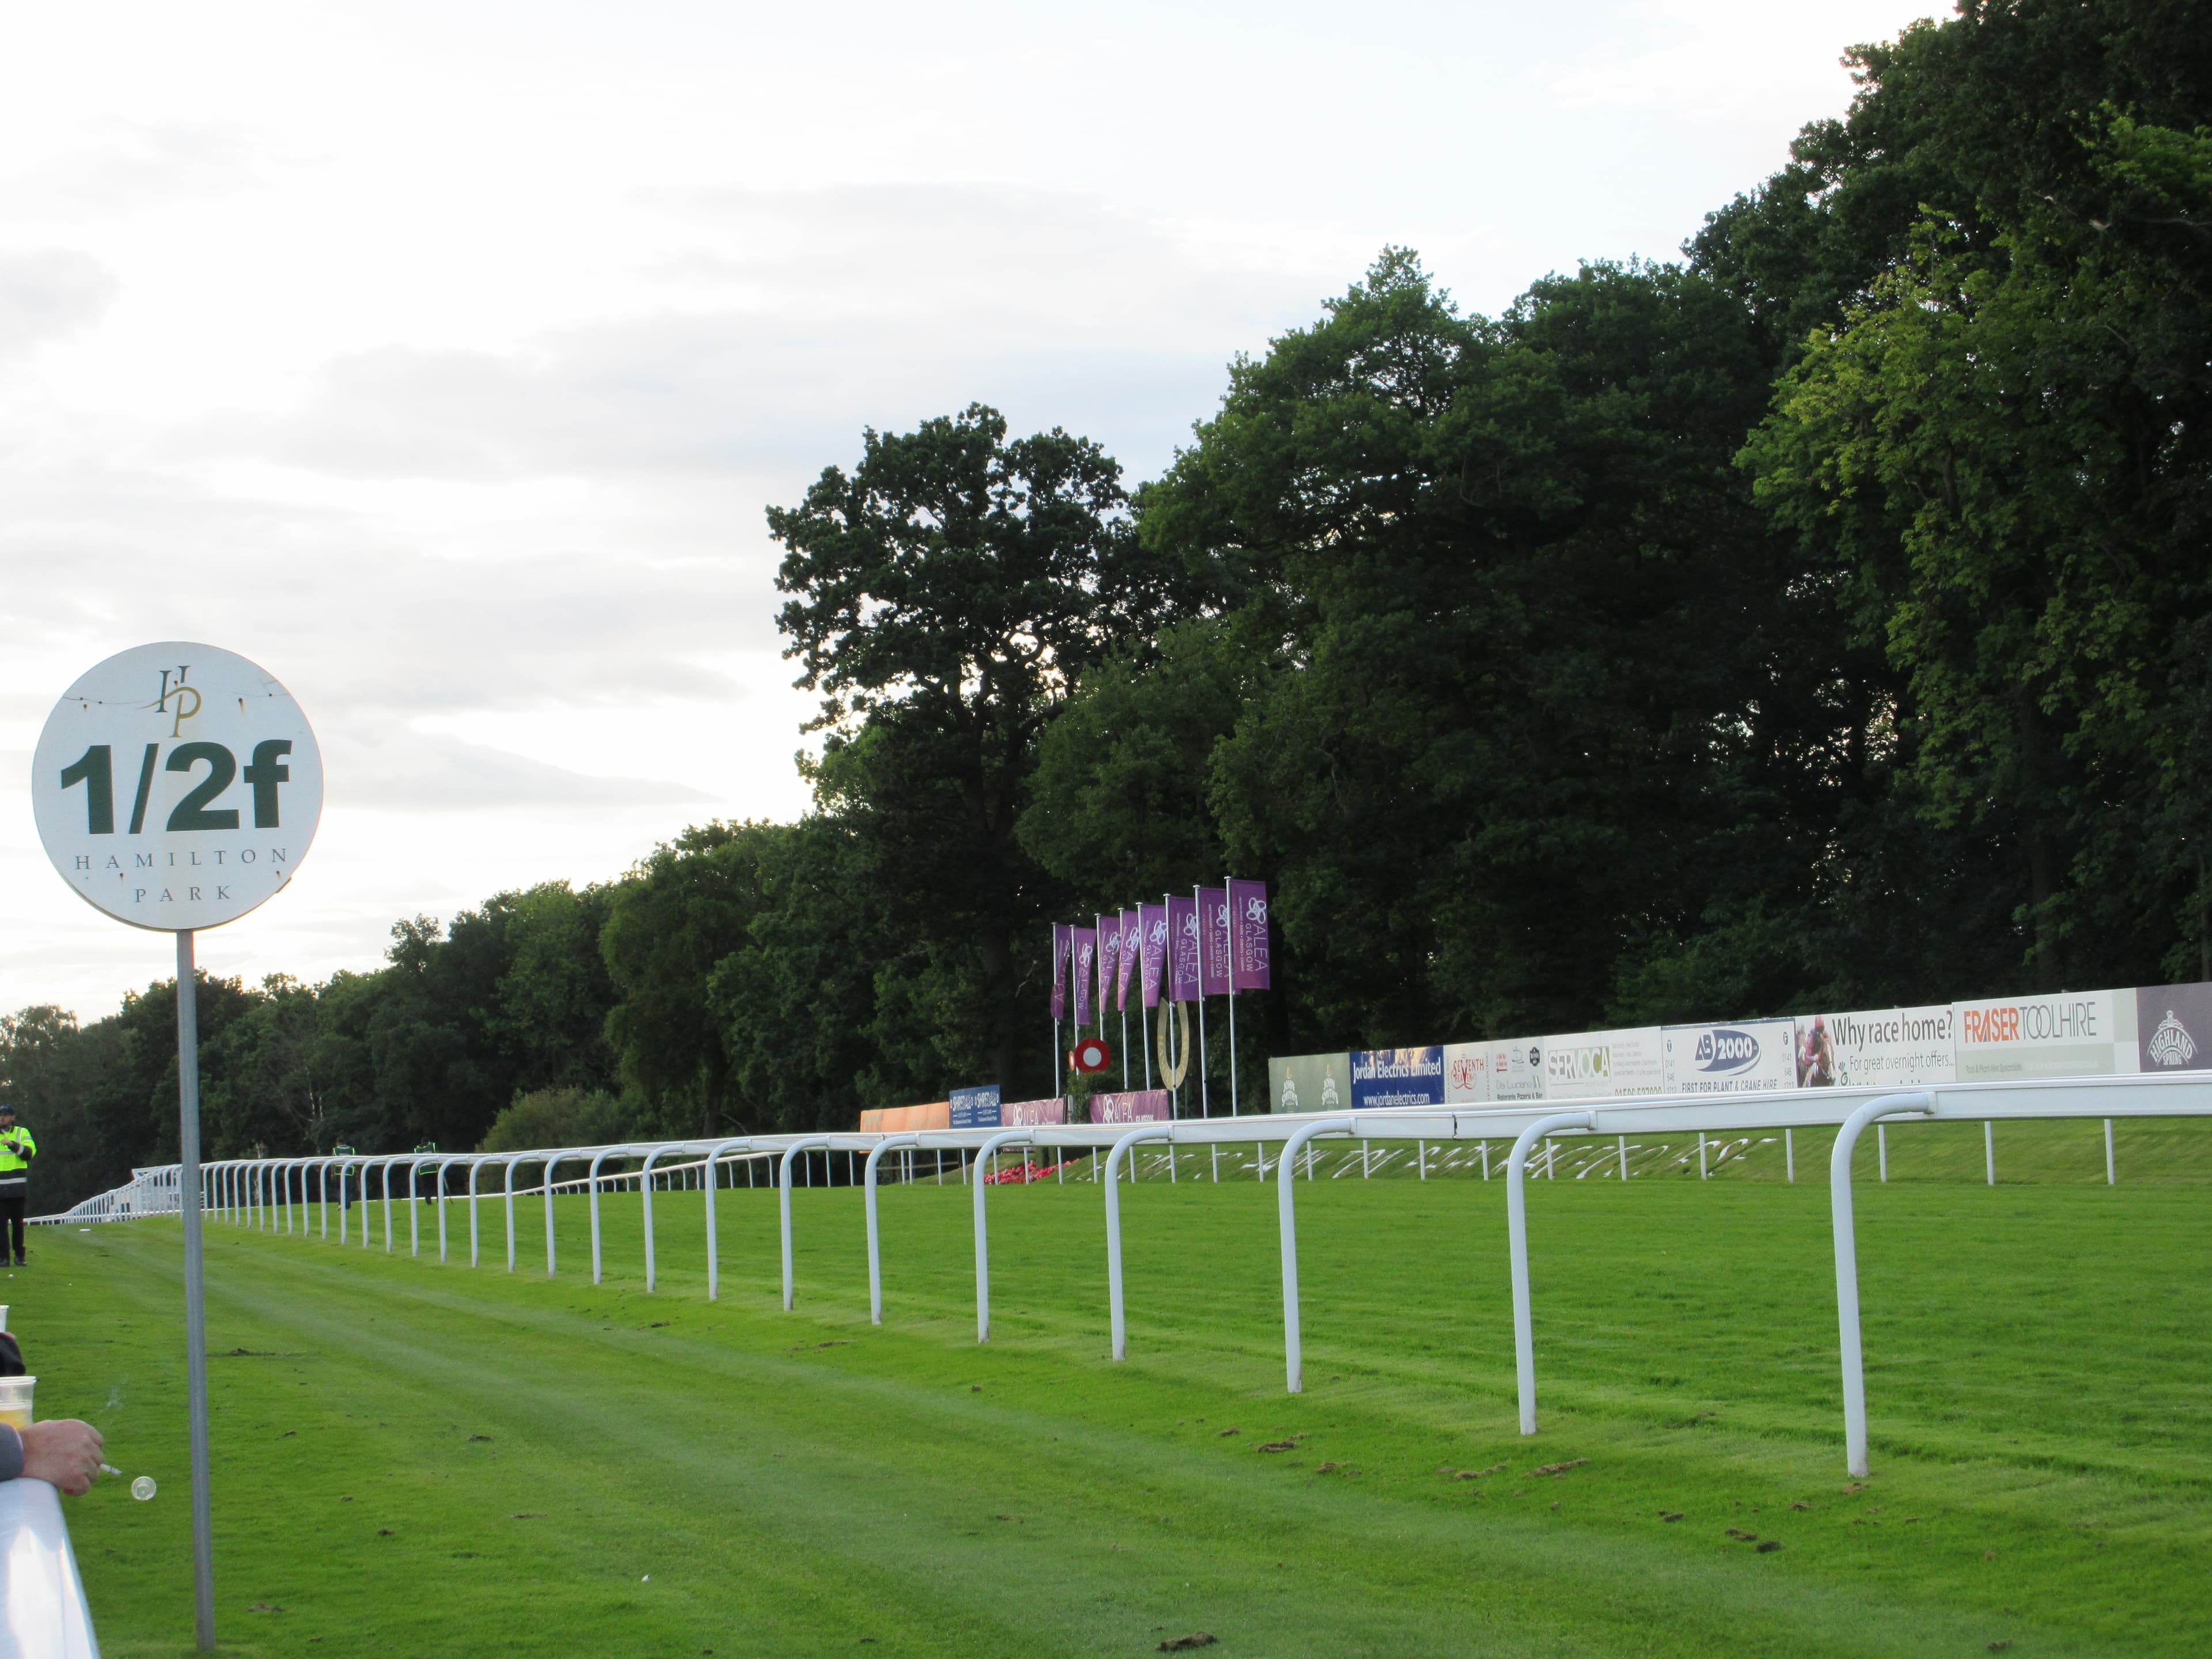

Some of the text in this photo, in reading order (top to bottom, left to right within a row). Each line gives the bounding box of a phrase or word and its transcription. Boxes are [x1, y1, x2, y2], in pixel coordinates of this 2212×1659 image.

[60, 739, 293, 835] 1/2f
[75, 848, 287, 870] HAMILTON
[135, 885, 231, 903] PARK
[1178, 938, 1187, 984] GLASGOW
[1253, 924, 1268, 971] ALEA
[1148, 945, 1162, 990] ALEA
[1184, 940, 1198, 984] ALEA
[1832, 1010, 1953, 1052] Why race home?
[1718, 1036, 1753, 1060] 2000
[2150, 1029, 2192, 1063] HIGHLAND
[2163, 1051, 2181, 1065] SPRING
[1353, 1056, 1441, 1084] Jordan Electrics Limited
[1453, 1059, 1484, 1078] SEVENTH
[1548, 1046, 1611, 1080] SERVOCA
[1850, 1055, 1862, 1071] For
[1864, 1054, 1883, 1074] great
[1886, 1051, 1923, 1072] overnight
[1363, 1090, 1430, 1107] www.jordanelectrics.com
[1681, 1082, 1696, 1093] FIRST
[1699, 1081, 1711, 1092] FOR
[1713, 1081, 1733, 1092] PLANT
[1735, 1081, 1738, 1091] &
[1740, 1080, 1761, 1090] CRANE
[1762, 1079, 1777, 1090] HIRE
